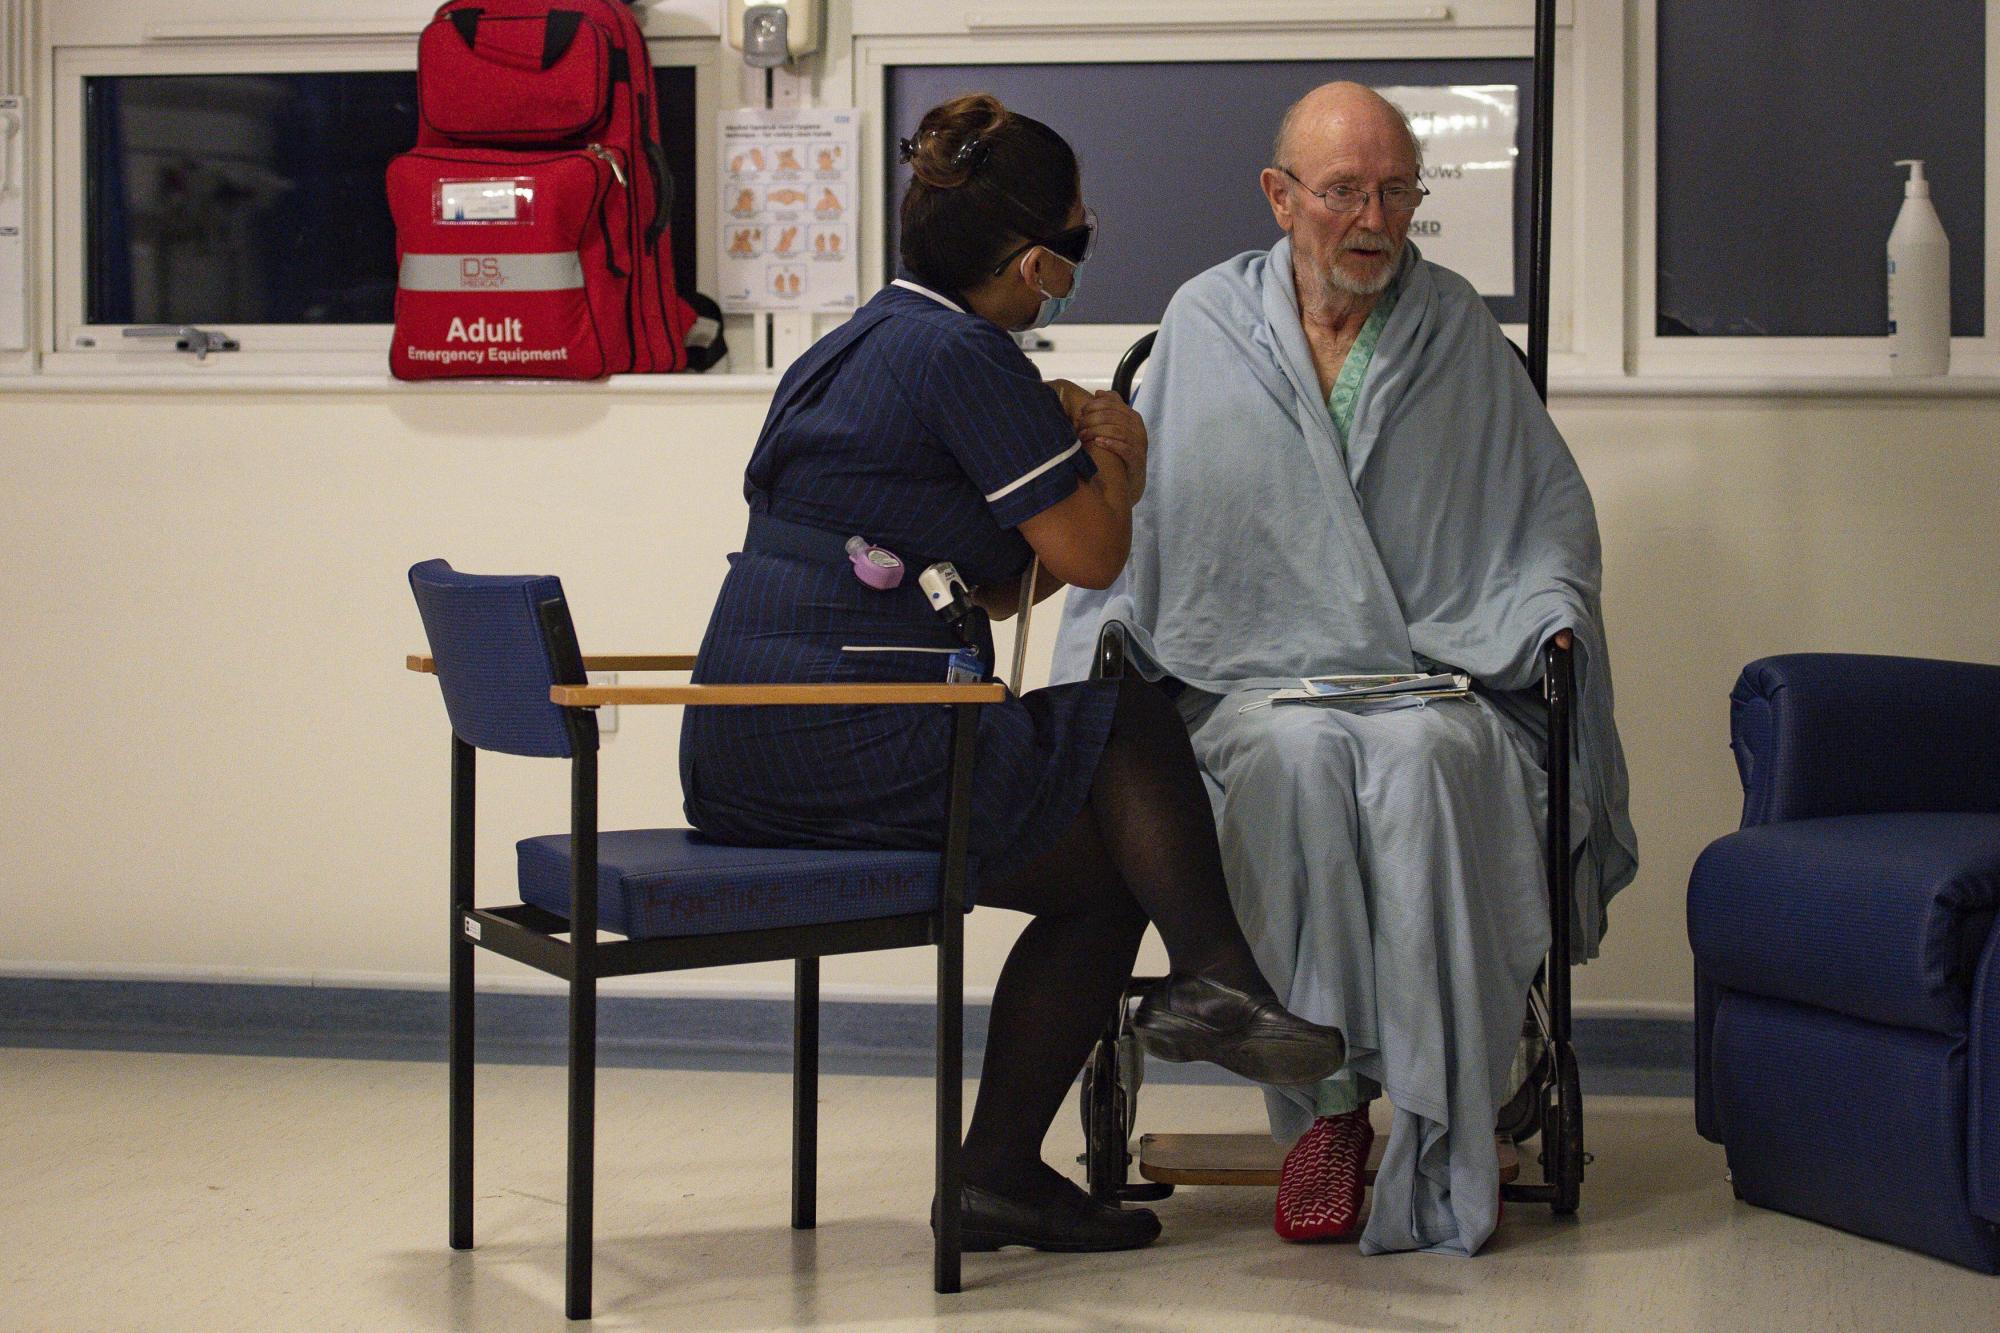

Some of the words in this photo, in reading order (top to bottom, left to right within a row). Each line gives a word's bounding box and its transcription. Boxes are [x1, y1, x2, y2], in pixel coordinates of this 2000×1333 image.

[446, 316, 524, 343] Adult
[407, 346, 484, 364] Emergency
[487, 346, 568, 364] Equipment
